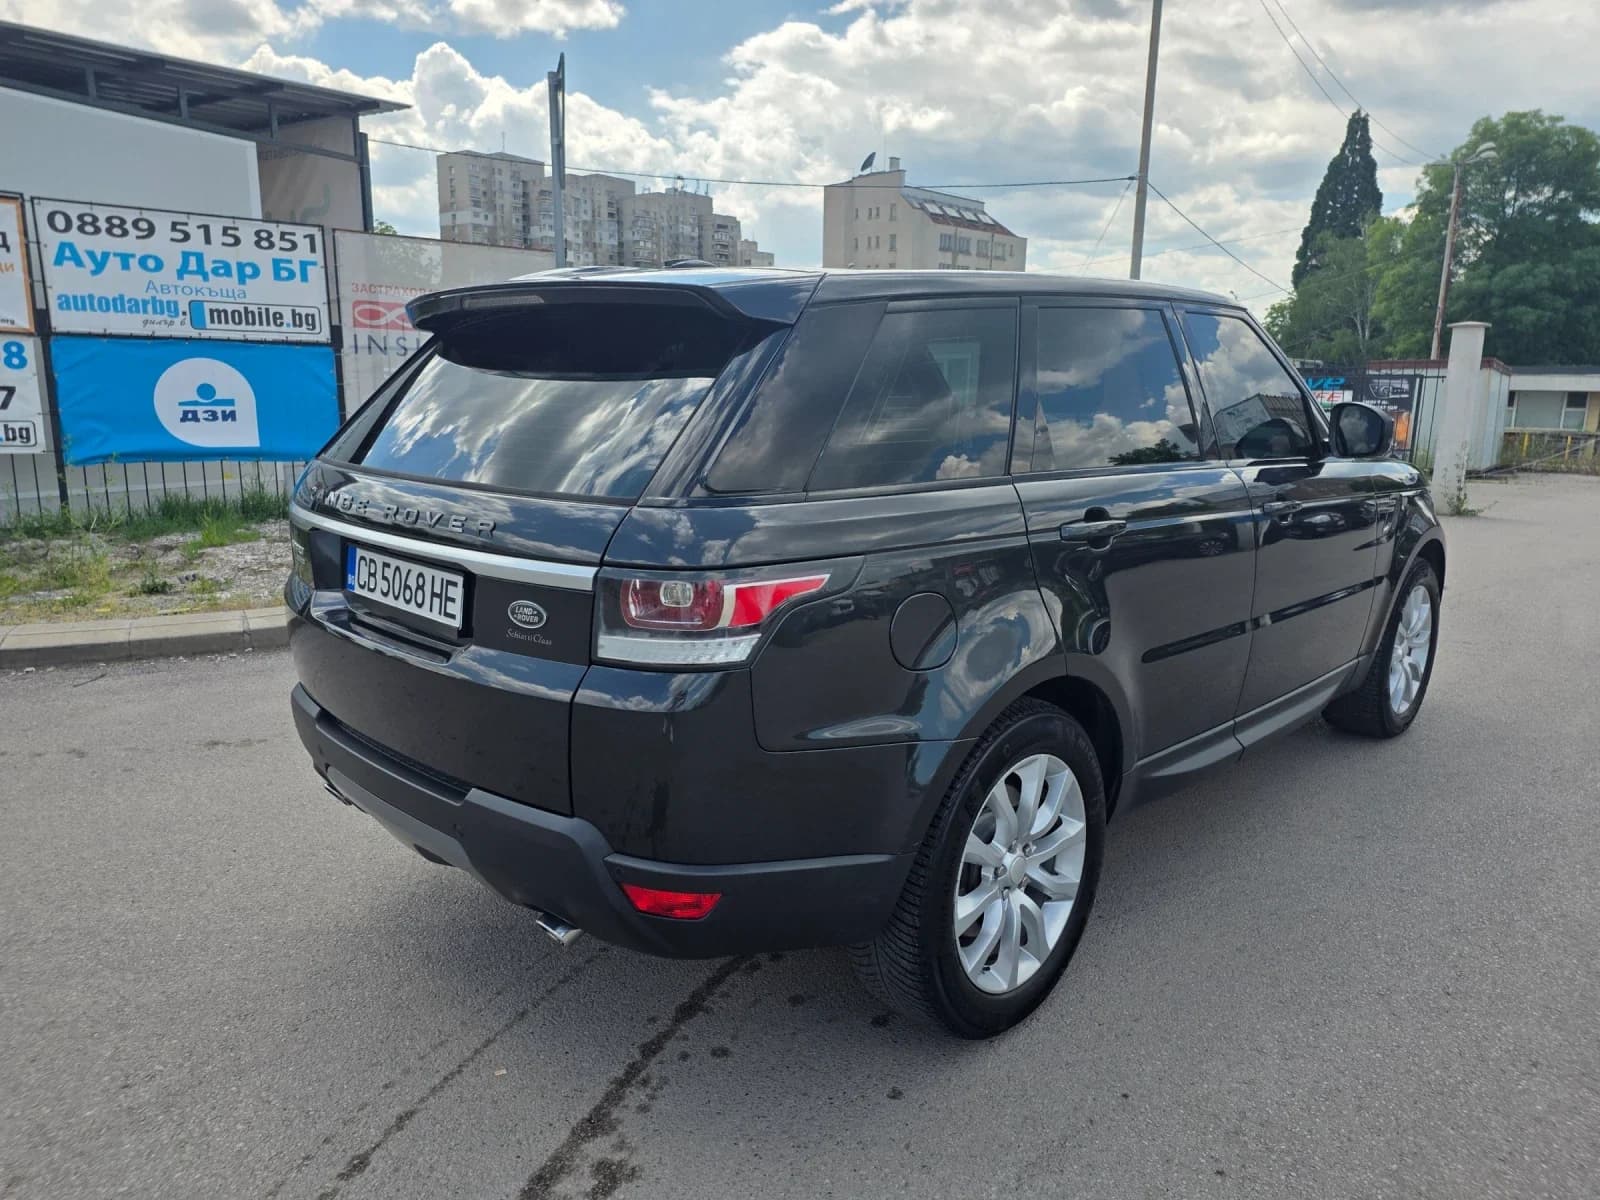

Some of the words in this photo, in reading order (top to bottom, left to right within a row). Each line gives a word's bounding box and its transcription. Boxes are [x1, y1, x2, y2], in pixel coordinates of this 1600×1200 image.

[47, 210, 156, 240] 0889
[170, 221, 242, 248] 515
[253, 229, 317, 254] 851
[53, 241, 164, 277] Ауто
[176, 250, 260, 285] Дар
[272, 257, 318, 283] БГ
[145, 280, 247, 300] Автокъща
[209, 306, 317, 331] mobile.bg
[3, 341, 28, 370] 8
[180, 409, 237, 423] ДЗИ
[384, 504, 497, 538] ROVER
